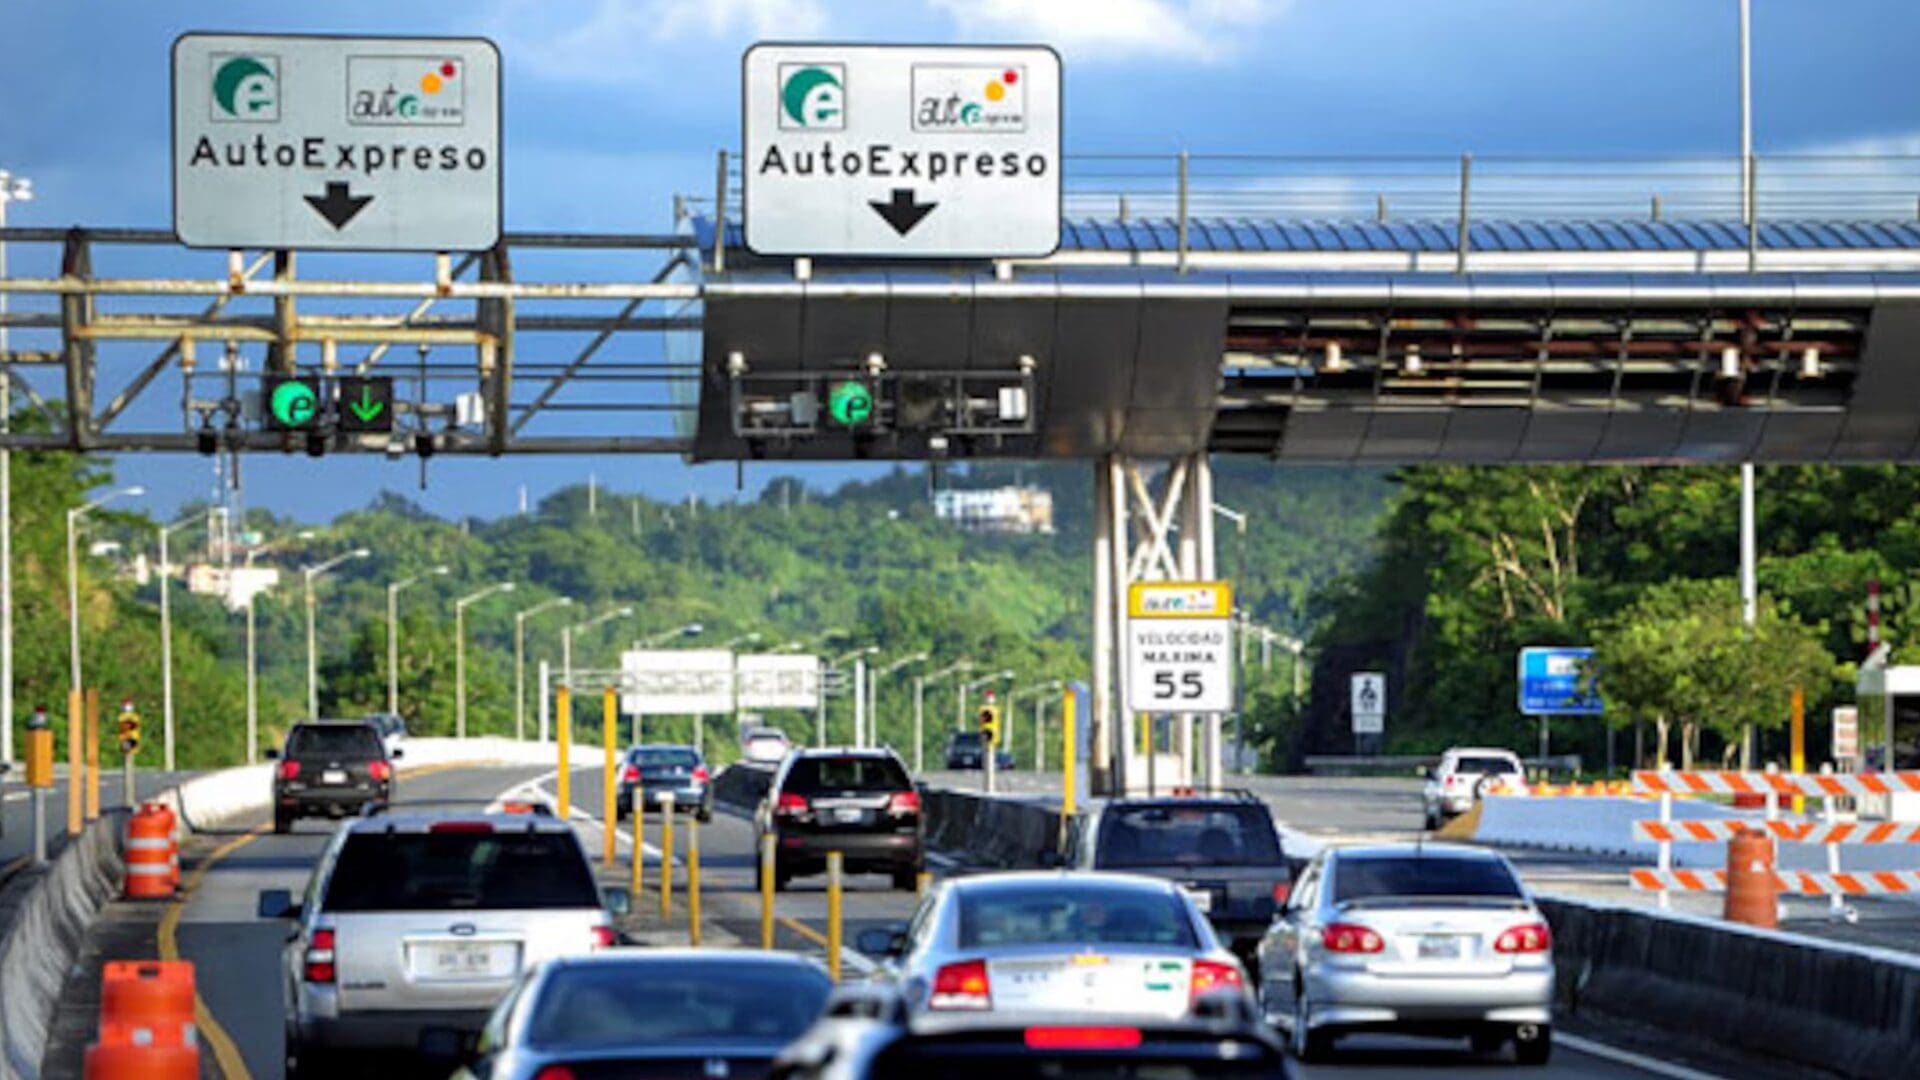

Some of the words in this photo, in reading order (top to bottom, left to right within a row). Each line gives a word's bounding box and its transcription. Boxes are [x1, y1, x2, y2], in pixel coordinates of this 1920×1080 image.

[189, 134, 487, 175] AutoExpreso
[759, 141, 1047, 181] AutoExpreso
[1154, 670, 1205, 699] 55
